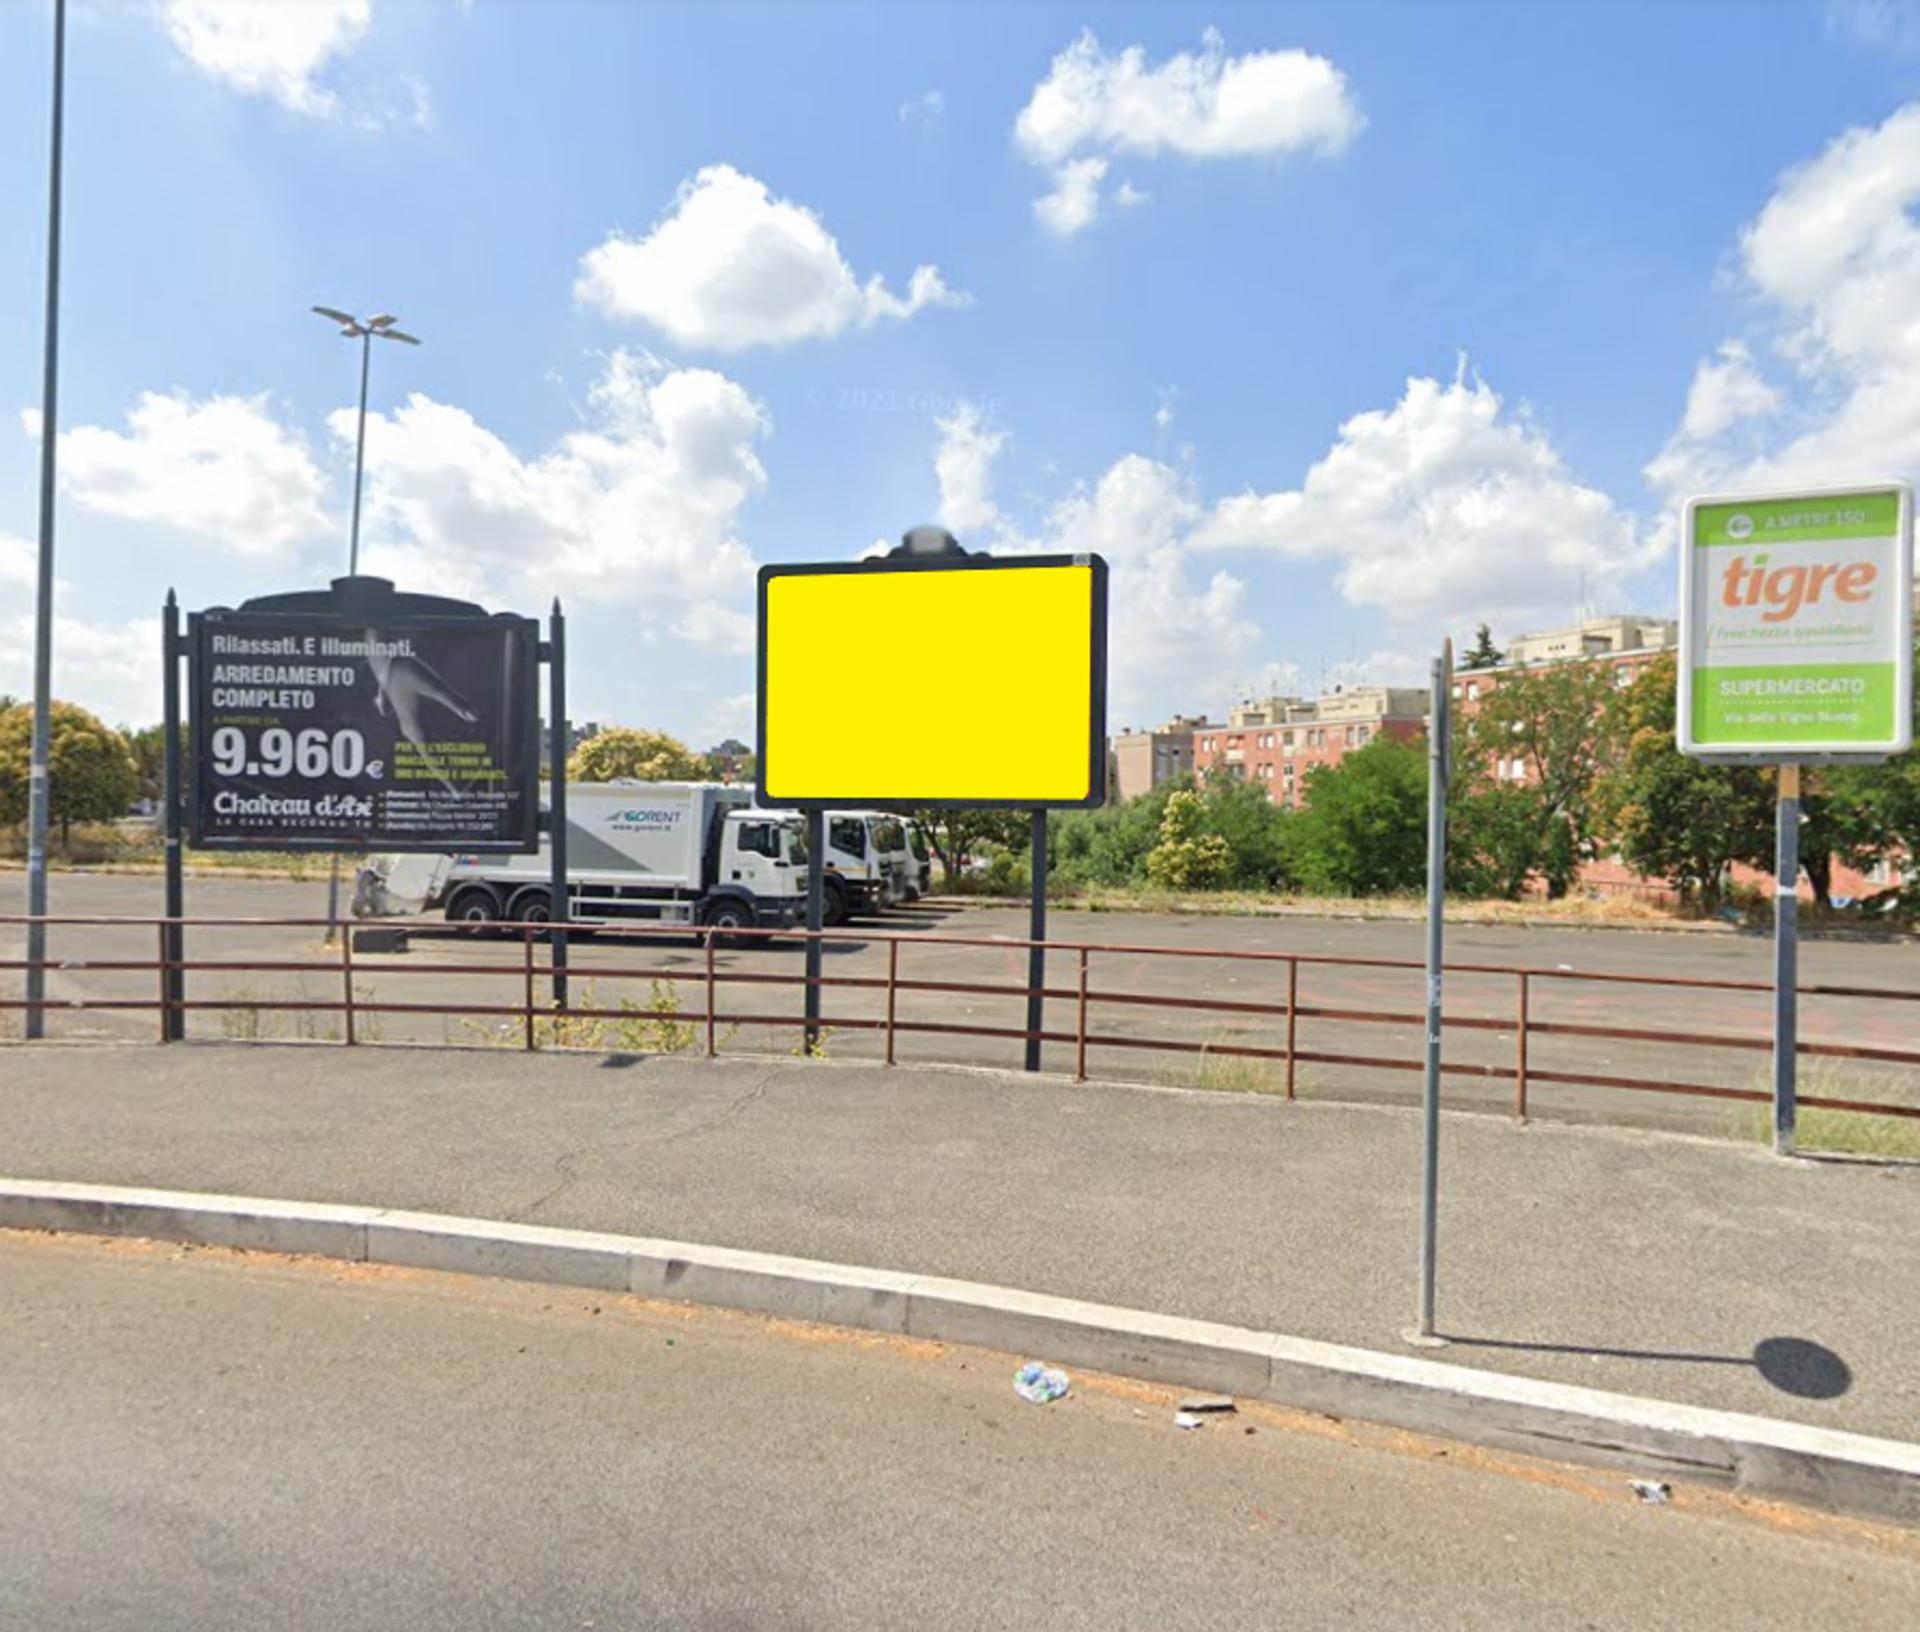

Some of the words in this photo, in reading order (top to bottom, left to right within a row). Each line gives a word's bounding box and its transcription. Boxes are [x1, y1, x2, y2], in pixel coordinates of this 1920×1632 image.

[1723, 553, 1878, 623] tigre
[212, 635, 301, 655] Rilassati.
[304, 637, 315, 655] E
[212, 665, 355, 686] ARREDAMENTO
[1720, 676, 1866, 696] SUPERMERCATO
[212, 688, 316, 710] COMPLETO
[214, 791, 312, 816] Chateau
[624, 809, 681, 822] GORENT
